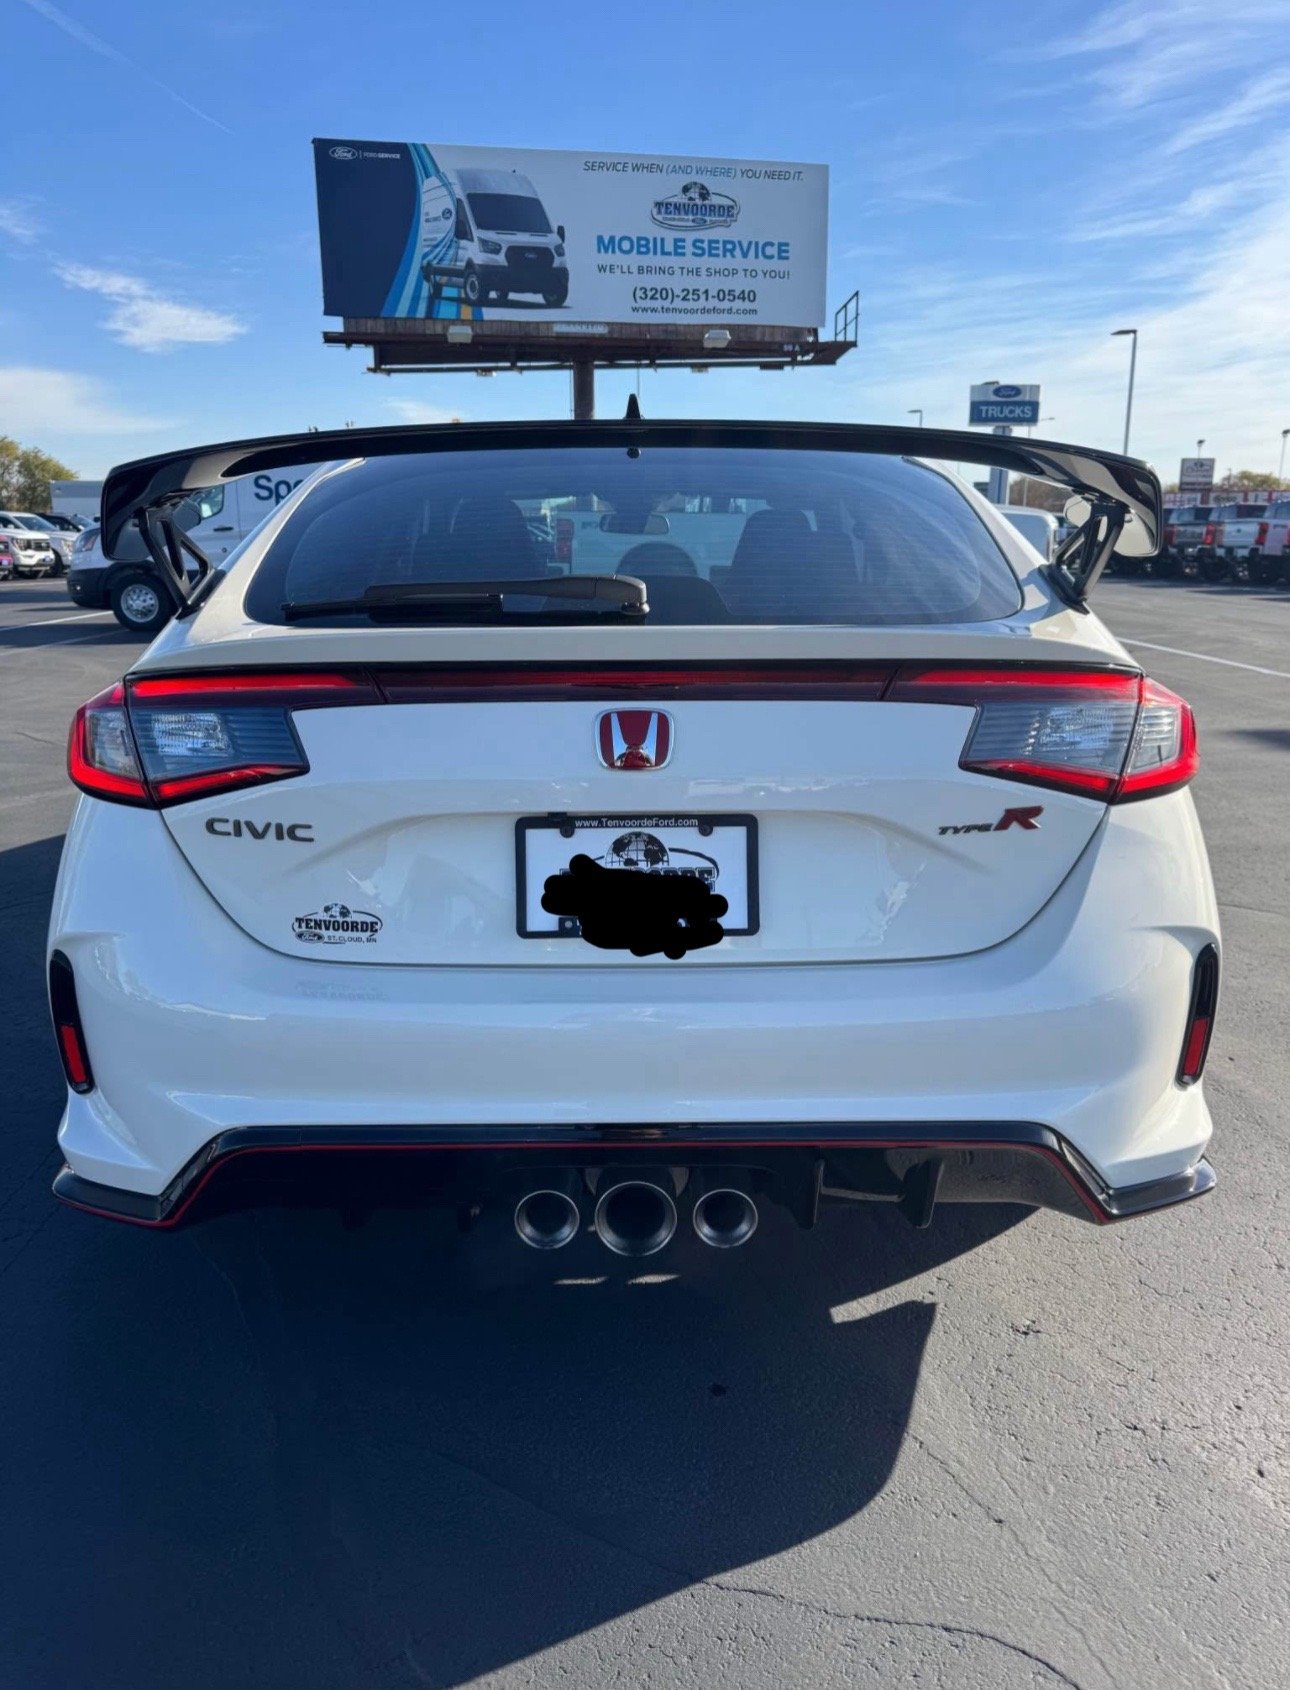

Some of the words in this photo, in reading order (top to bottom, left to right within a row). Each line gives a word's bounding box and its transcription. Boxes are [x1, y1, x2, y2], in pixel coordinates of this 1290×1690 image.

[583, 160, 629, 173] SERVICE
[631, 162, 664, 174] WHEN
[665, 164, 693, 176] (AND
[695, 166, 737, 180] WHERE)
[740, 168, 762, 180] YOU
[763, 169, 792, 181] NEED
[793, 170, 804, 181] IT.
[654, 201, 736, 218] TENVOORDE
[596, 235, 686, 257] MOBILE
[691, 238, 790, 260] SERVICE
[597, 264, 634, 275] WE'LL
[637, 265, 675, 276] BRING
[679, 267, 702, 277] THE
[705, 267, 738, 278] SHOP
[742, 268, 758, 279] TO
[762, 270, 790, 280] YOU!
[632, 286, 757, 304] (320)-251-0540
[631, 305, 758, 316] www.tenvoordeford.com
[979, 405, 1033, 418] TRUCKS
[574, 817, 699, 828] www.TenvoordeFord.com
[938, 822, 994, 835] TYPE
[993, 805, 1044, 831] R
[205, 817, 315, 842] CIVIC
[295, 917, 379, 933] TENVOORDE
[338, 936, 365, 944] CLOUD,
